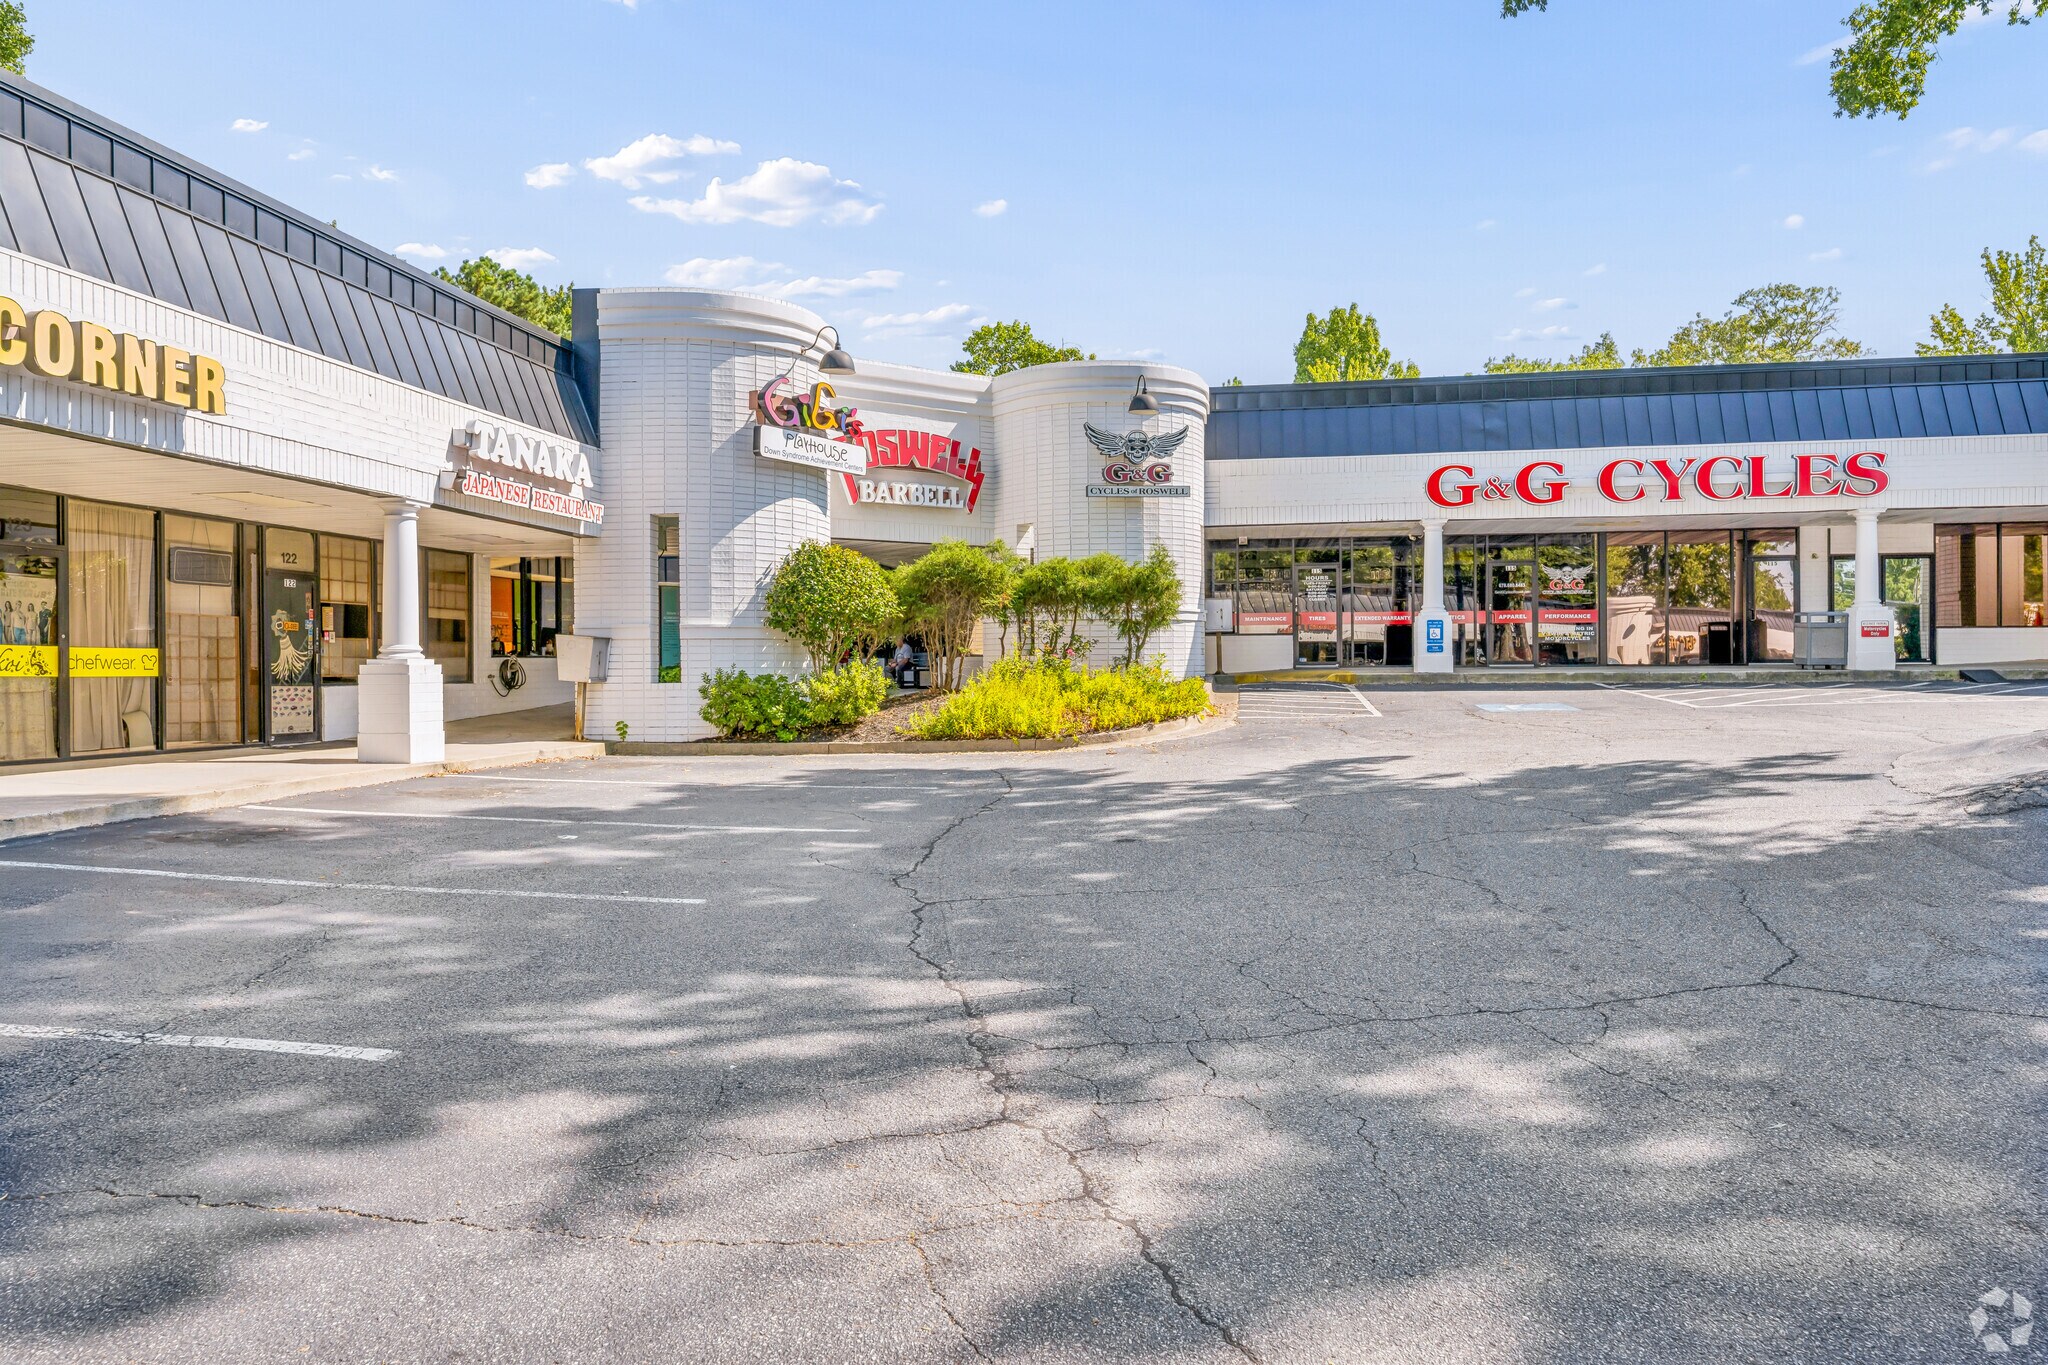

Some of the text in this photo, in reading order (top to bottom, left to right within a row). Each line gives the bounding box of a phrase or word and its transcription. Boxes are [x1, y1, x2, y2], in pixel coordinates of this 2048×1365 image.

[0, 296, 227, 416] CORNER
[468, 419, 594, 489] TANAKA
[763, 446, 864, 473] Down Syndrome Achievement Centers
[1104, 463, 1174, 484] G&G
[1424, 450, 1891, 509] G&G CYCLES
[463, 472, 604, 523] JAPANESE RESTAURANT
[857, 479, 965, 509] BARBELL
[1090, 487, 1189, 496] CYCLES of ROSWELL
[281, 552, 298, 564] 122
[284, 579, 296, 587] 122
[1549, 579, 1586, 590] G&G
